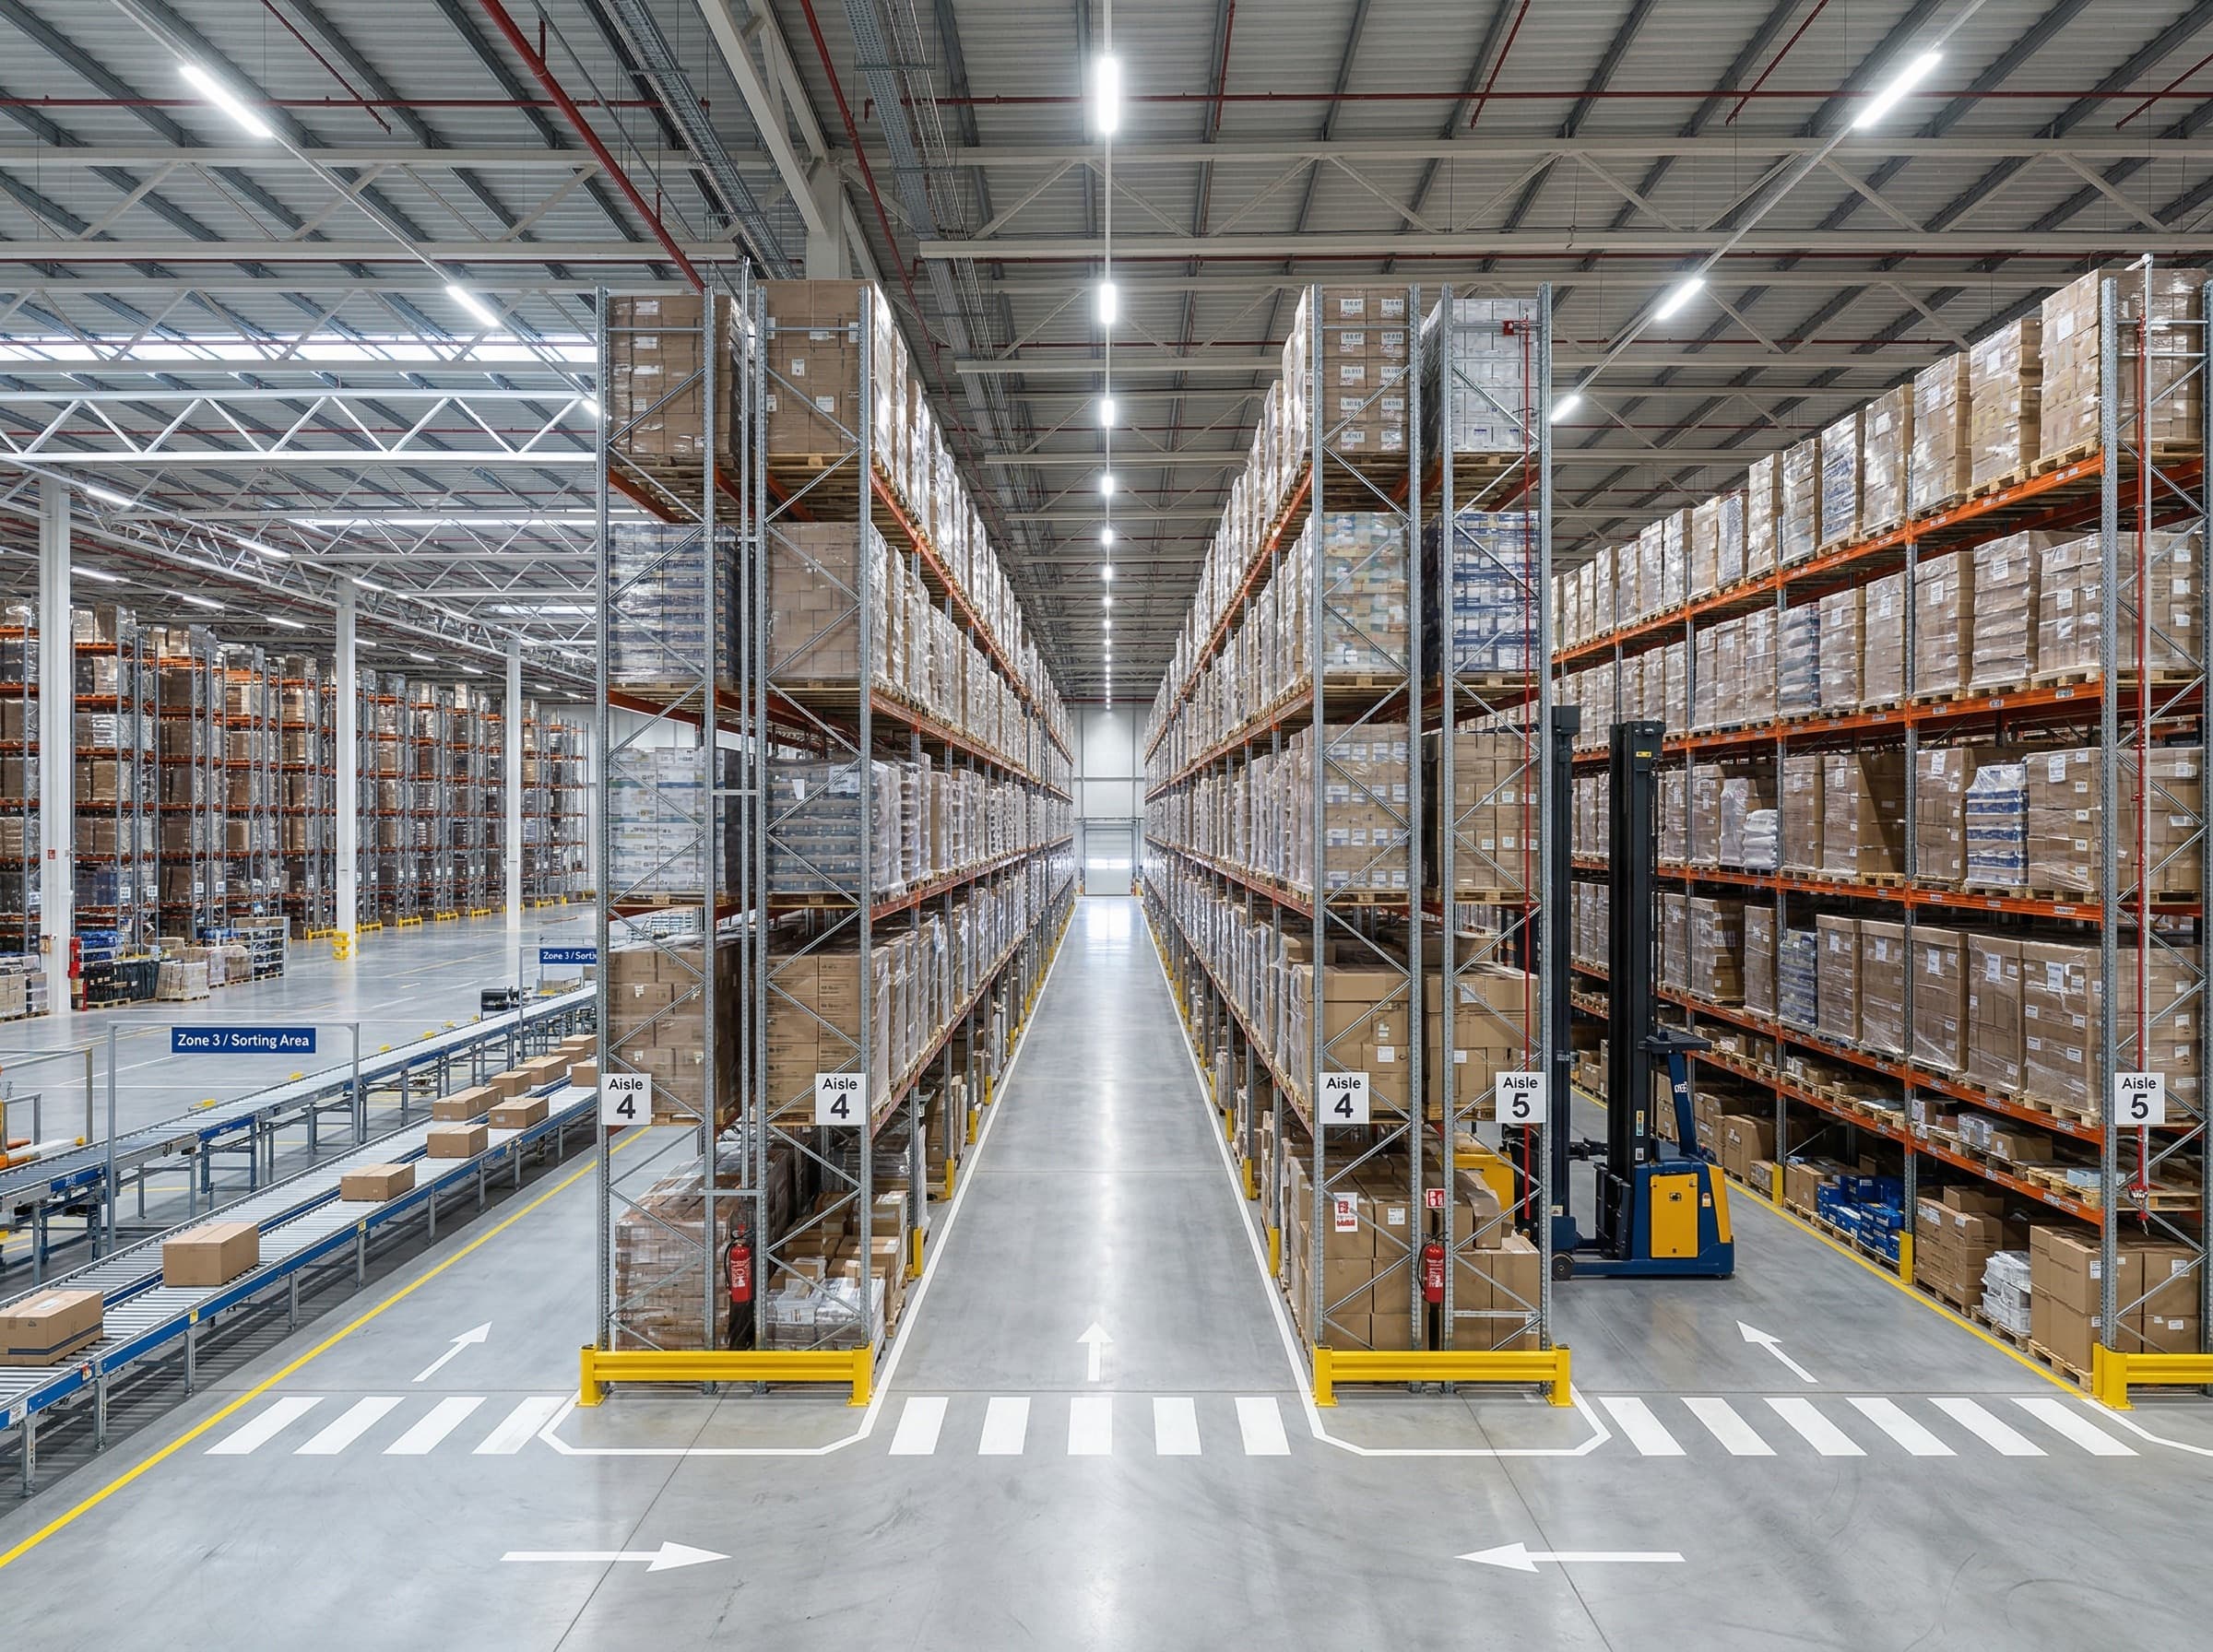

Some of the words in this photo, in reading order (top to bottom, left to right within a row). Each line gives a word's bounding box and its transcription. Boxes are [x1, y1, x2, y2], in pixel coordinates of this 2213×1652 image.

[564, 951, 570, 960] 3
[177, 1033, 210, 1046] Zone
[212, 1033, 220, 1046] 3
[222, 1033, 229, 1047] /
[231, 1033, 278, 1049] Sorting
[279, 1033, 310, 1046] Area
[609, 1078, 644, 1091] Aisle
[822, 1077, 858, 1091] Aisle
[1326, 1076, 1361, 1089] Aisle
[1502, 1076, 1538, 1089] Aisle
[2121, 1076, 2157, 1089] Aisle
[617, 1093, 636, 1120] 4
[830, 1092, 850, 1119] 4
[1333, 1092, 1354, 1119] 4
[1511, 1092, 1531, 1119] 5
[2130, 1093, 2149, 1120] 5
